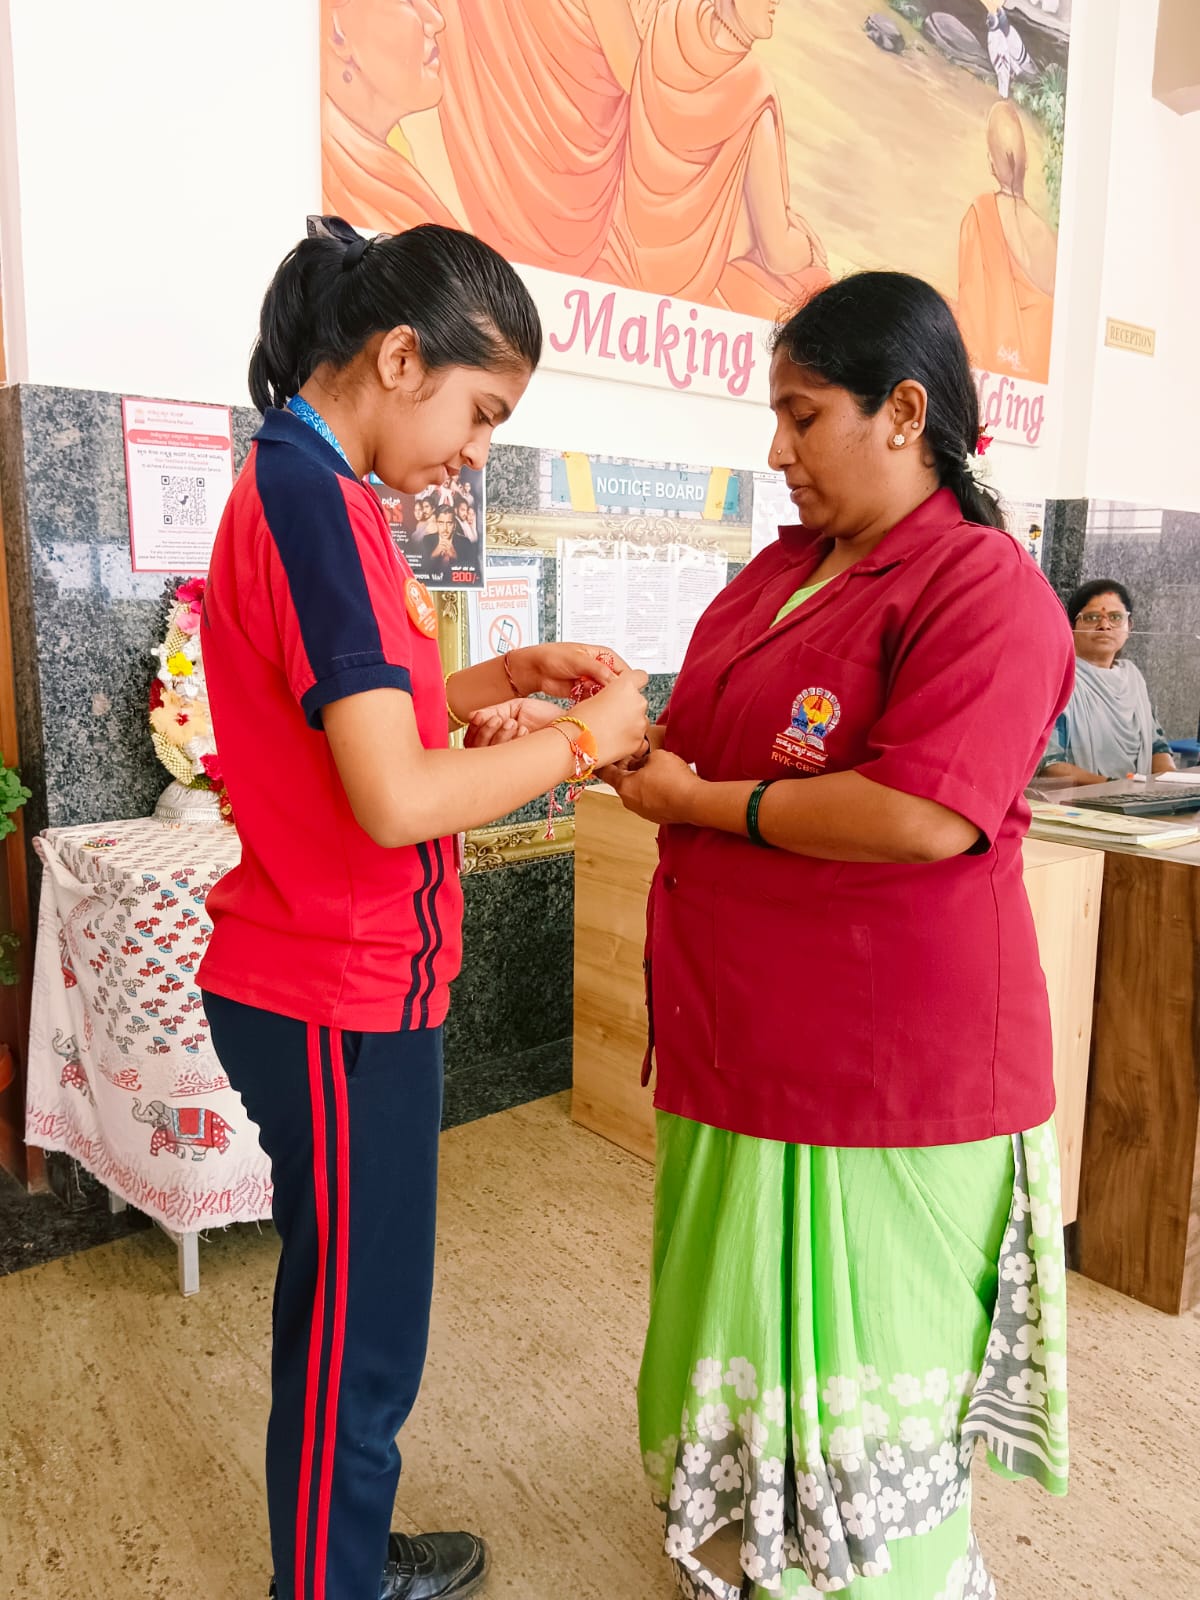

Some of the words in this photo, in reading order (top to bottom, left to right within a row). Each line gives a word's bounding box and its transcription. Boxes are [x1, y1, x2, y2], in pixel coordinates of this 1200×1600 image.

[1110, 326, 1152, 348] RECEPTION
[549, 289, 755, 396] Making
[978, 372, 1044, 444] lding
[597, 477, 651, 497] NOTICE
[655, 482, 704, 500] BOARD
[481, 584, 527, 597] BEWARE
[481, 602, 495, 610] CELL
[496, 601, 515, 609] PHONE
